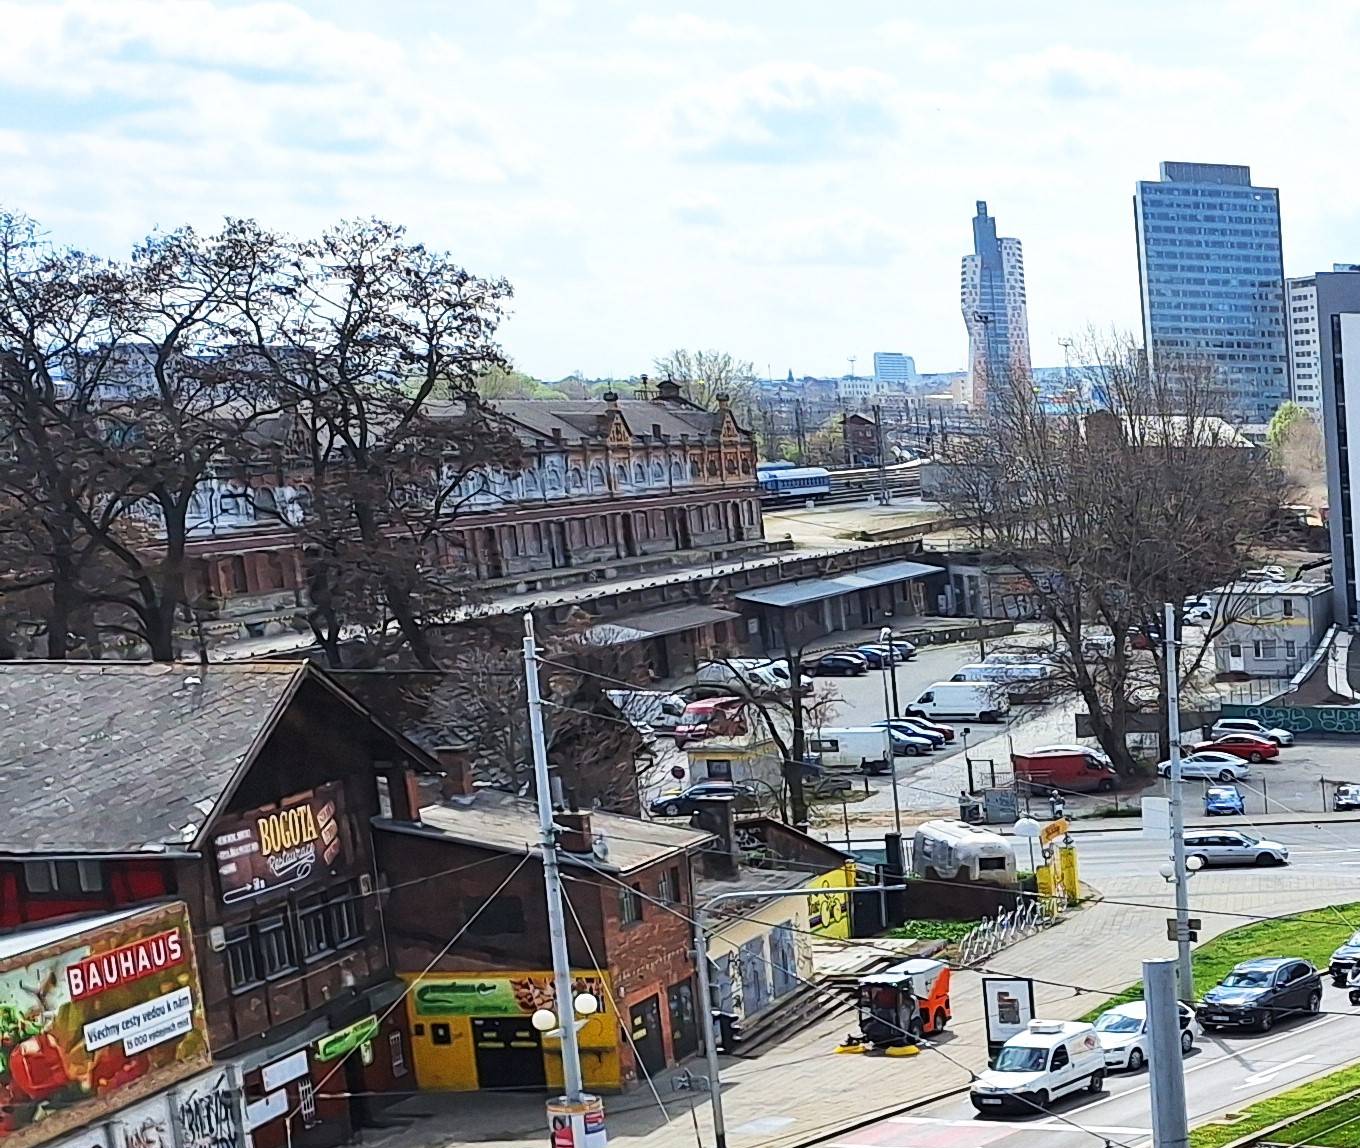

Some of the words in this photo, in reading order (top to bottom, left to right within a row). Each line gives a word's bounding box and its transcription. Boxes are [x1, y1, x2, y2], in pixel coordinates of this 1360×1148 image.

[258, 804, 318, 856] BOGOTA
[69, 933, 182, 996] BAUHAUS
[87, 1024, 119, 1043] Všechny
[121, 1015, 140, 1031] cesty
